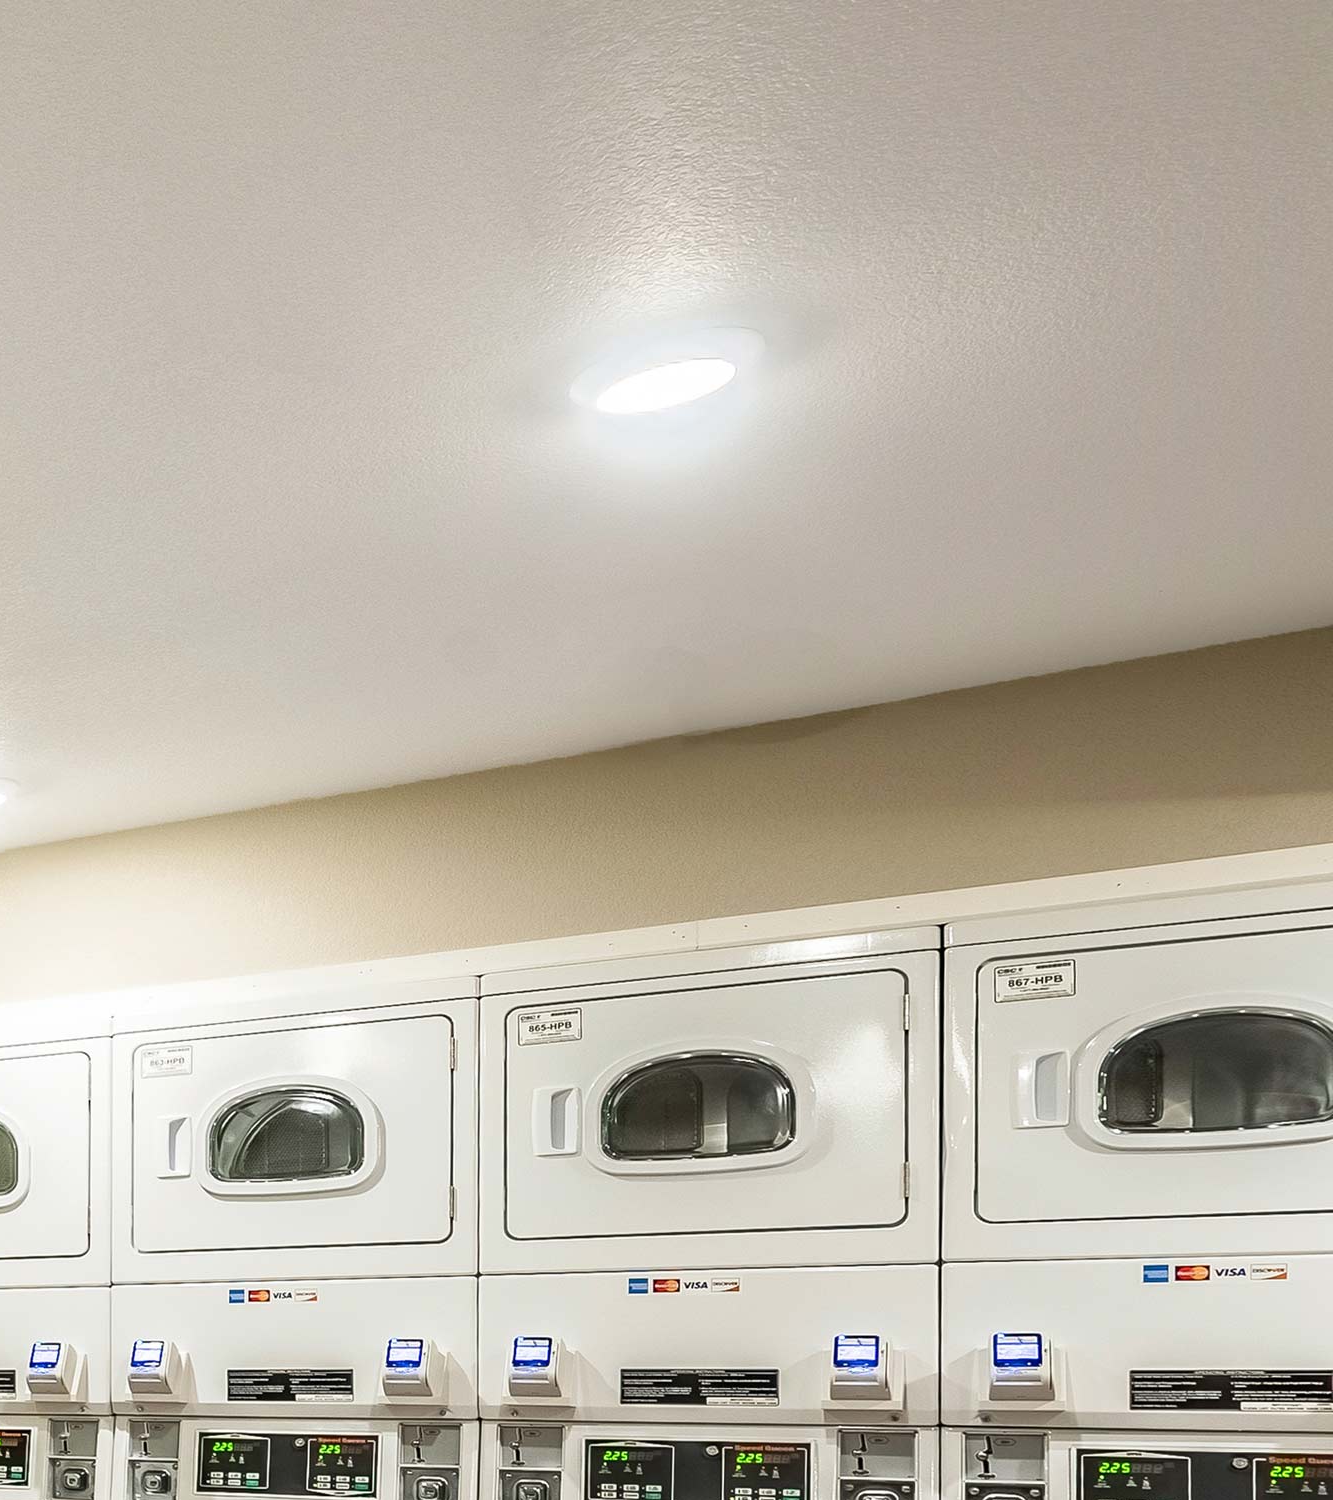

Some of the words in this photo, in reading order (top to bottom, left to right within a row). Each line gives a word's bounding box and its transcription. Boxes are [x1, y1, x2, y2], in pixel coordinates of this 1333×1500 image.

[1008, 975, 1063, 987] 867-HPB
[528, 1021, 572, 1032] 865-HPB
[1215, 1268, 1246, 1277] VISA
[683, 1281, 708, 1289] VISA
[603, 1451, 628, 1461] 2.25
[736, 1452, 763, 1463] 2.25
[1099, 1462, 1131, 1473] 2.25
[1270, 1466, 1304, 1478] 2.25
